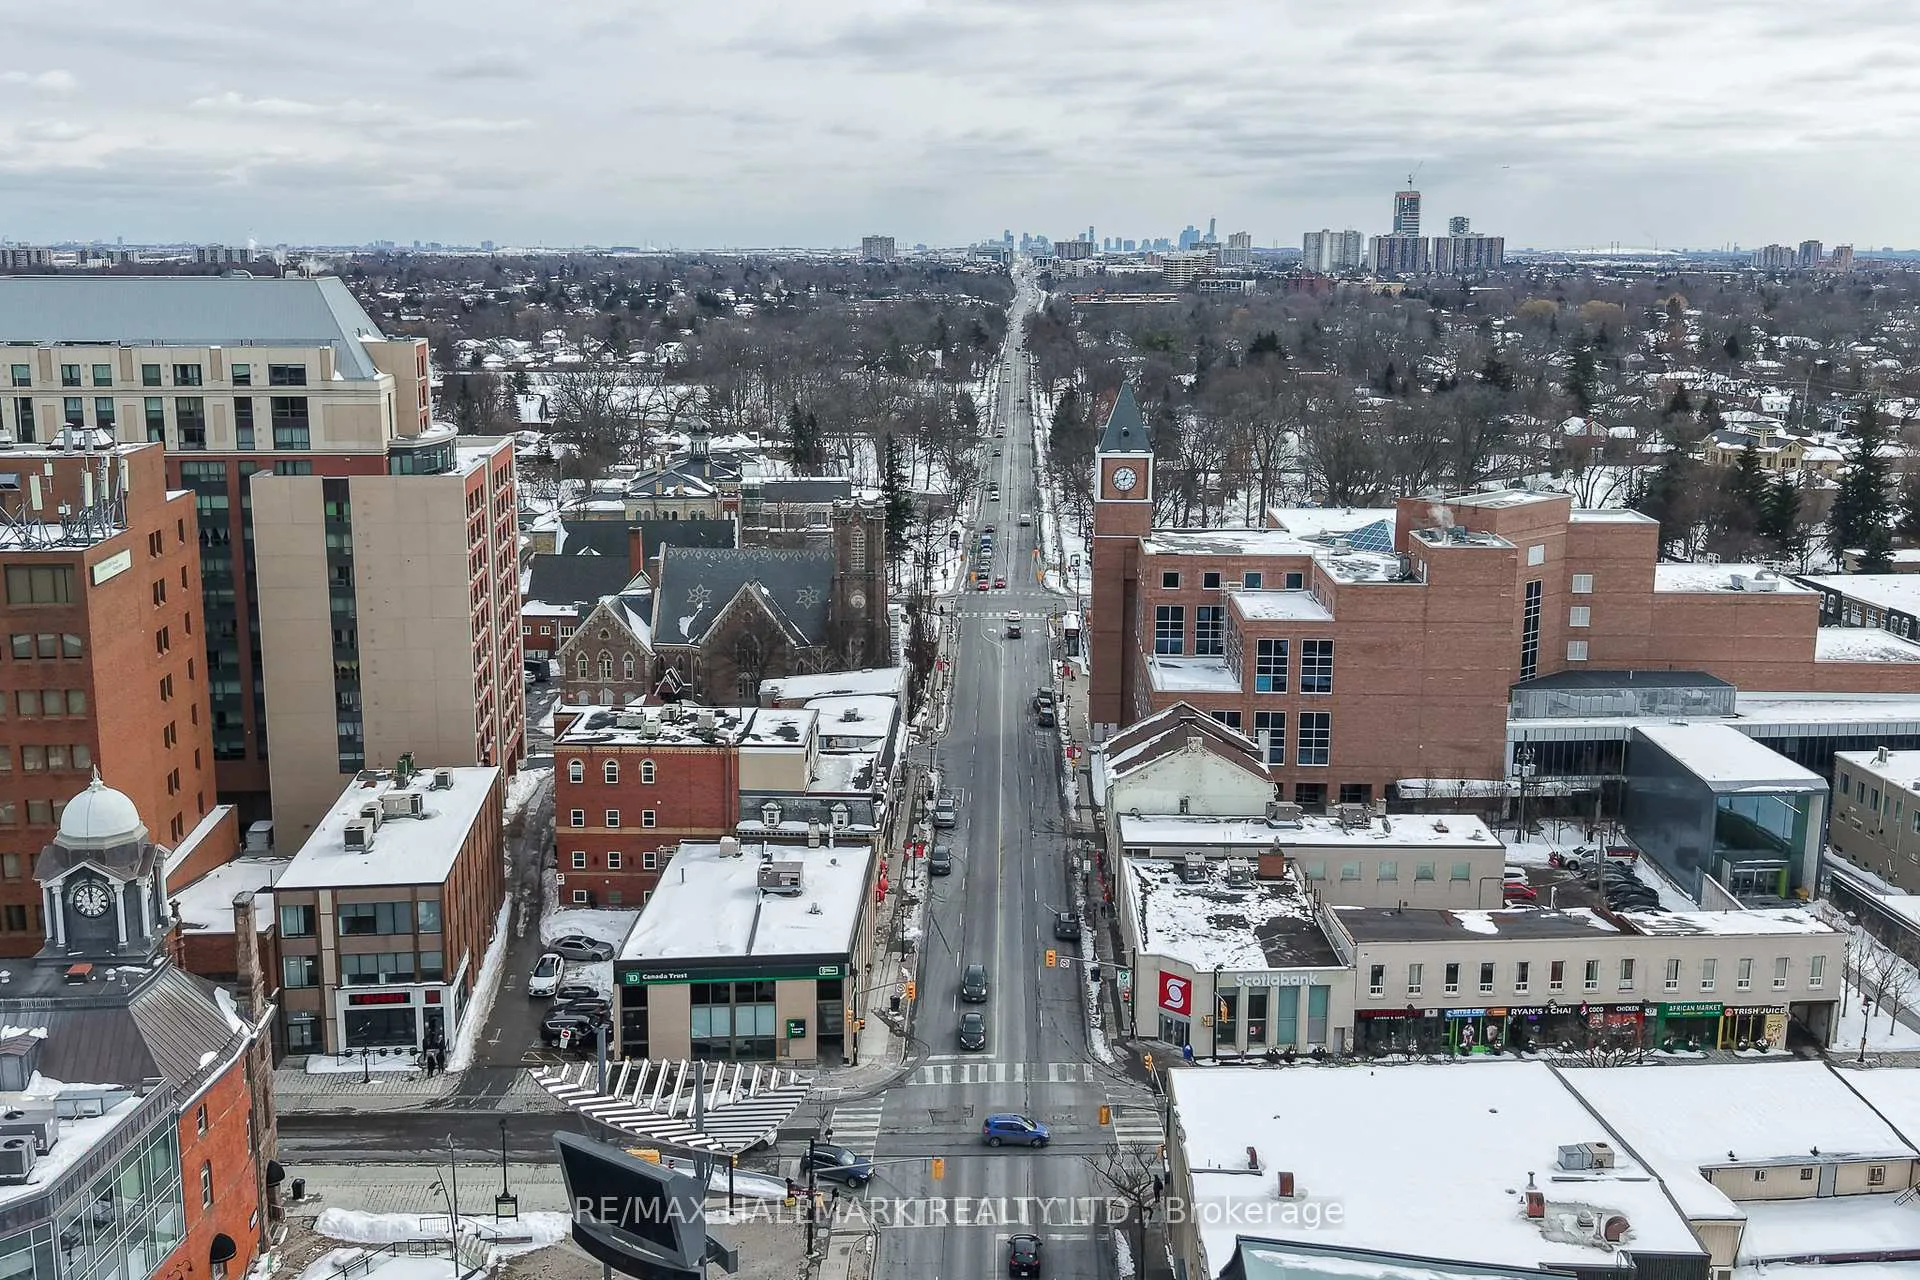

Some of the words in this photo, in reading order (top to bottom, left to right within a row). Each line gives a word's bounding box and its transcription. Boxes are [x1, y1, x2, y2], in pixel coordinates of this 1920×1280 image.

[1235, 972, 1319, 986] Scotiabank
[1511, 1008, 1543, 1016] RYAN'S
[1550, 1007, 1571, 1015] CHAI
[1668, 1004, 1695, 1012] AFRICAN
